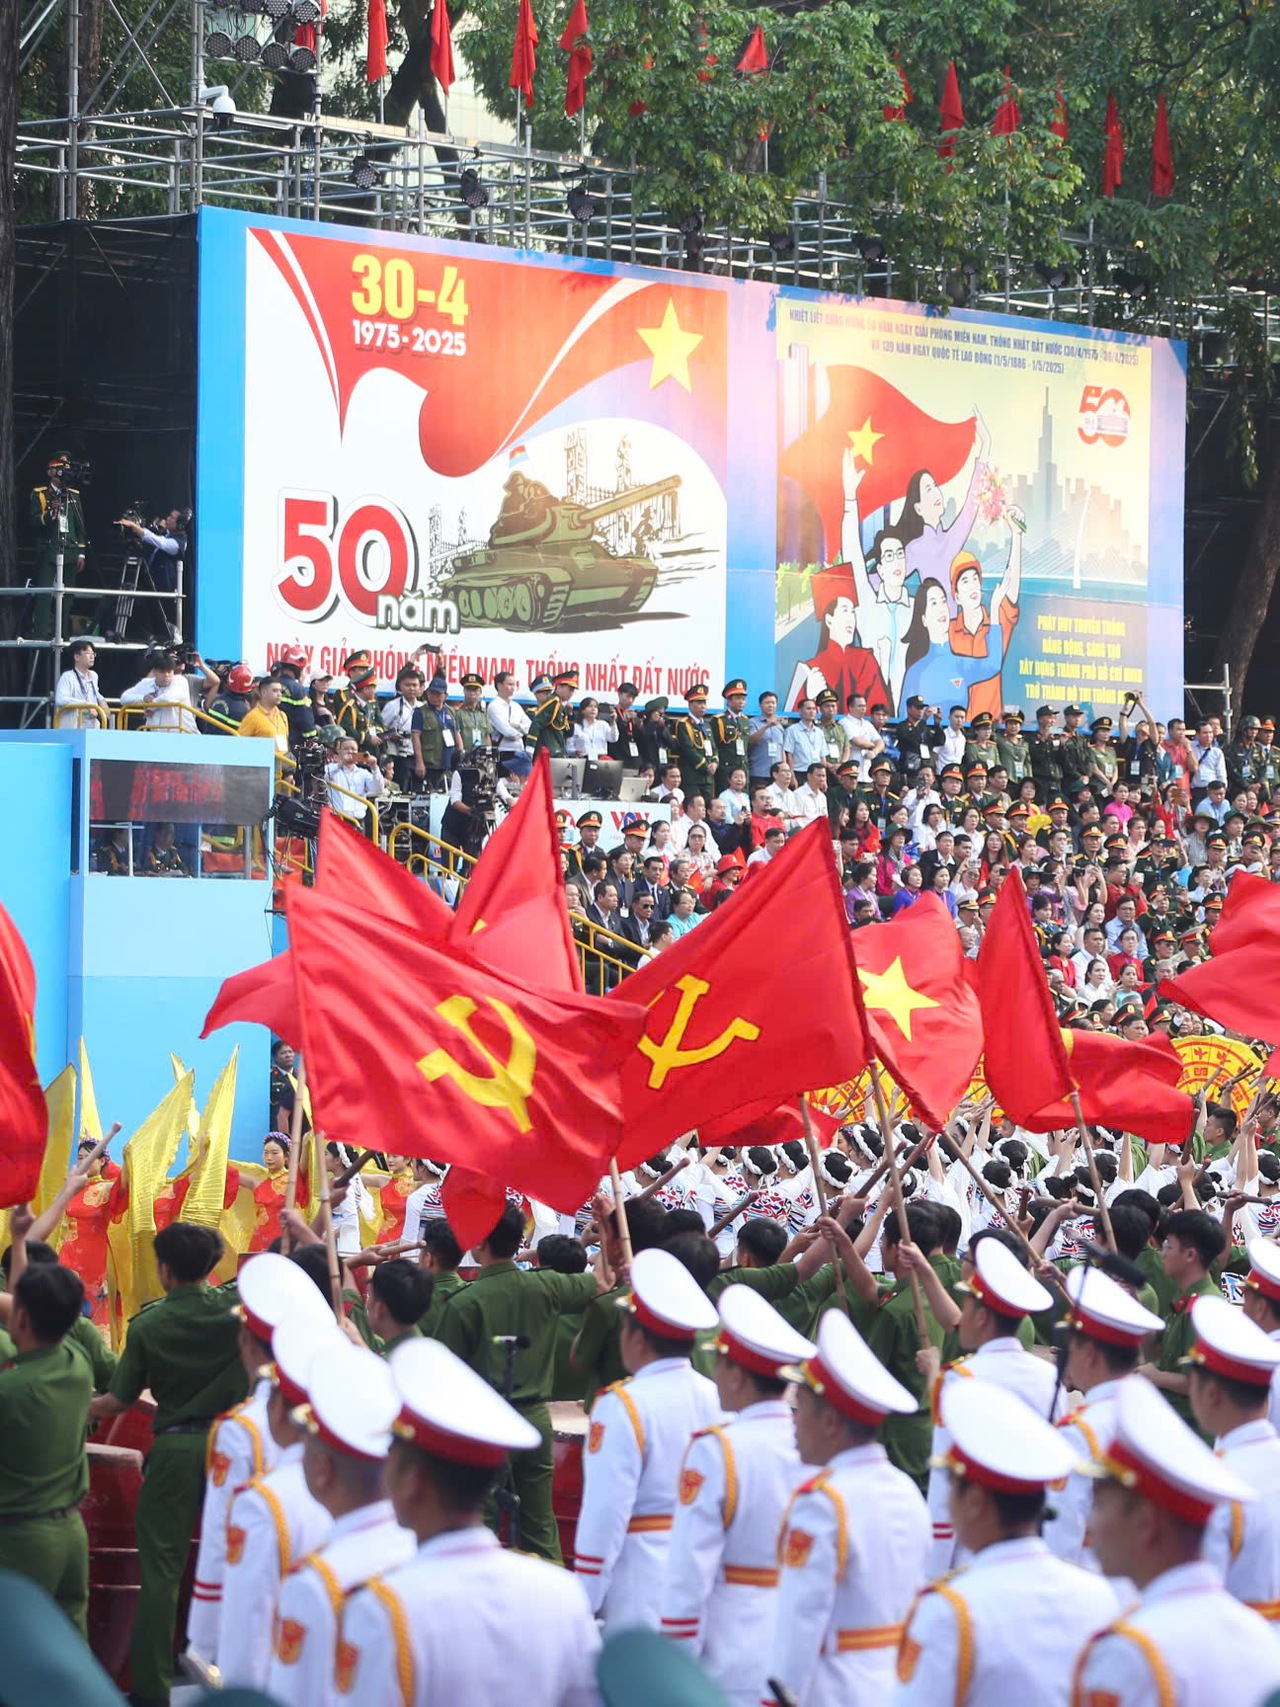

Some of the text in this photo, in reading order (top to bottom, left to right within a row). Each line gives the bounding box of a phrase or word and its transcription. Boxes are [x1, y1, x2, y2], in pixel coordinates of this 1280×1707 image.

[352, 254, 468, 325] 30-4
[961, 350, 973, 363] LAO
[276, 494, 460, 633] 50 năm
[585, 653, 628, 692] NHẤT
[632, 656, 663, 695] ĐẤT
